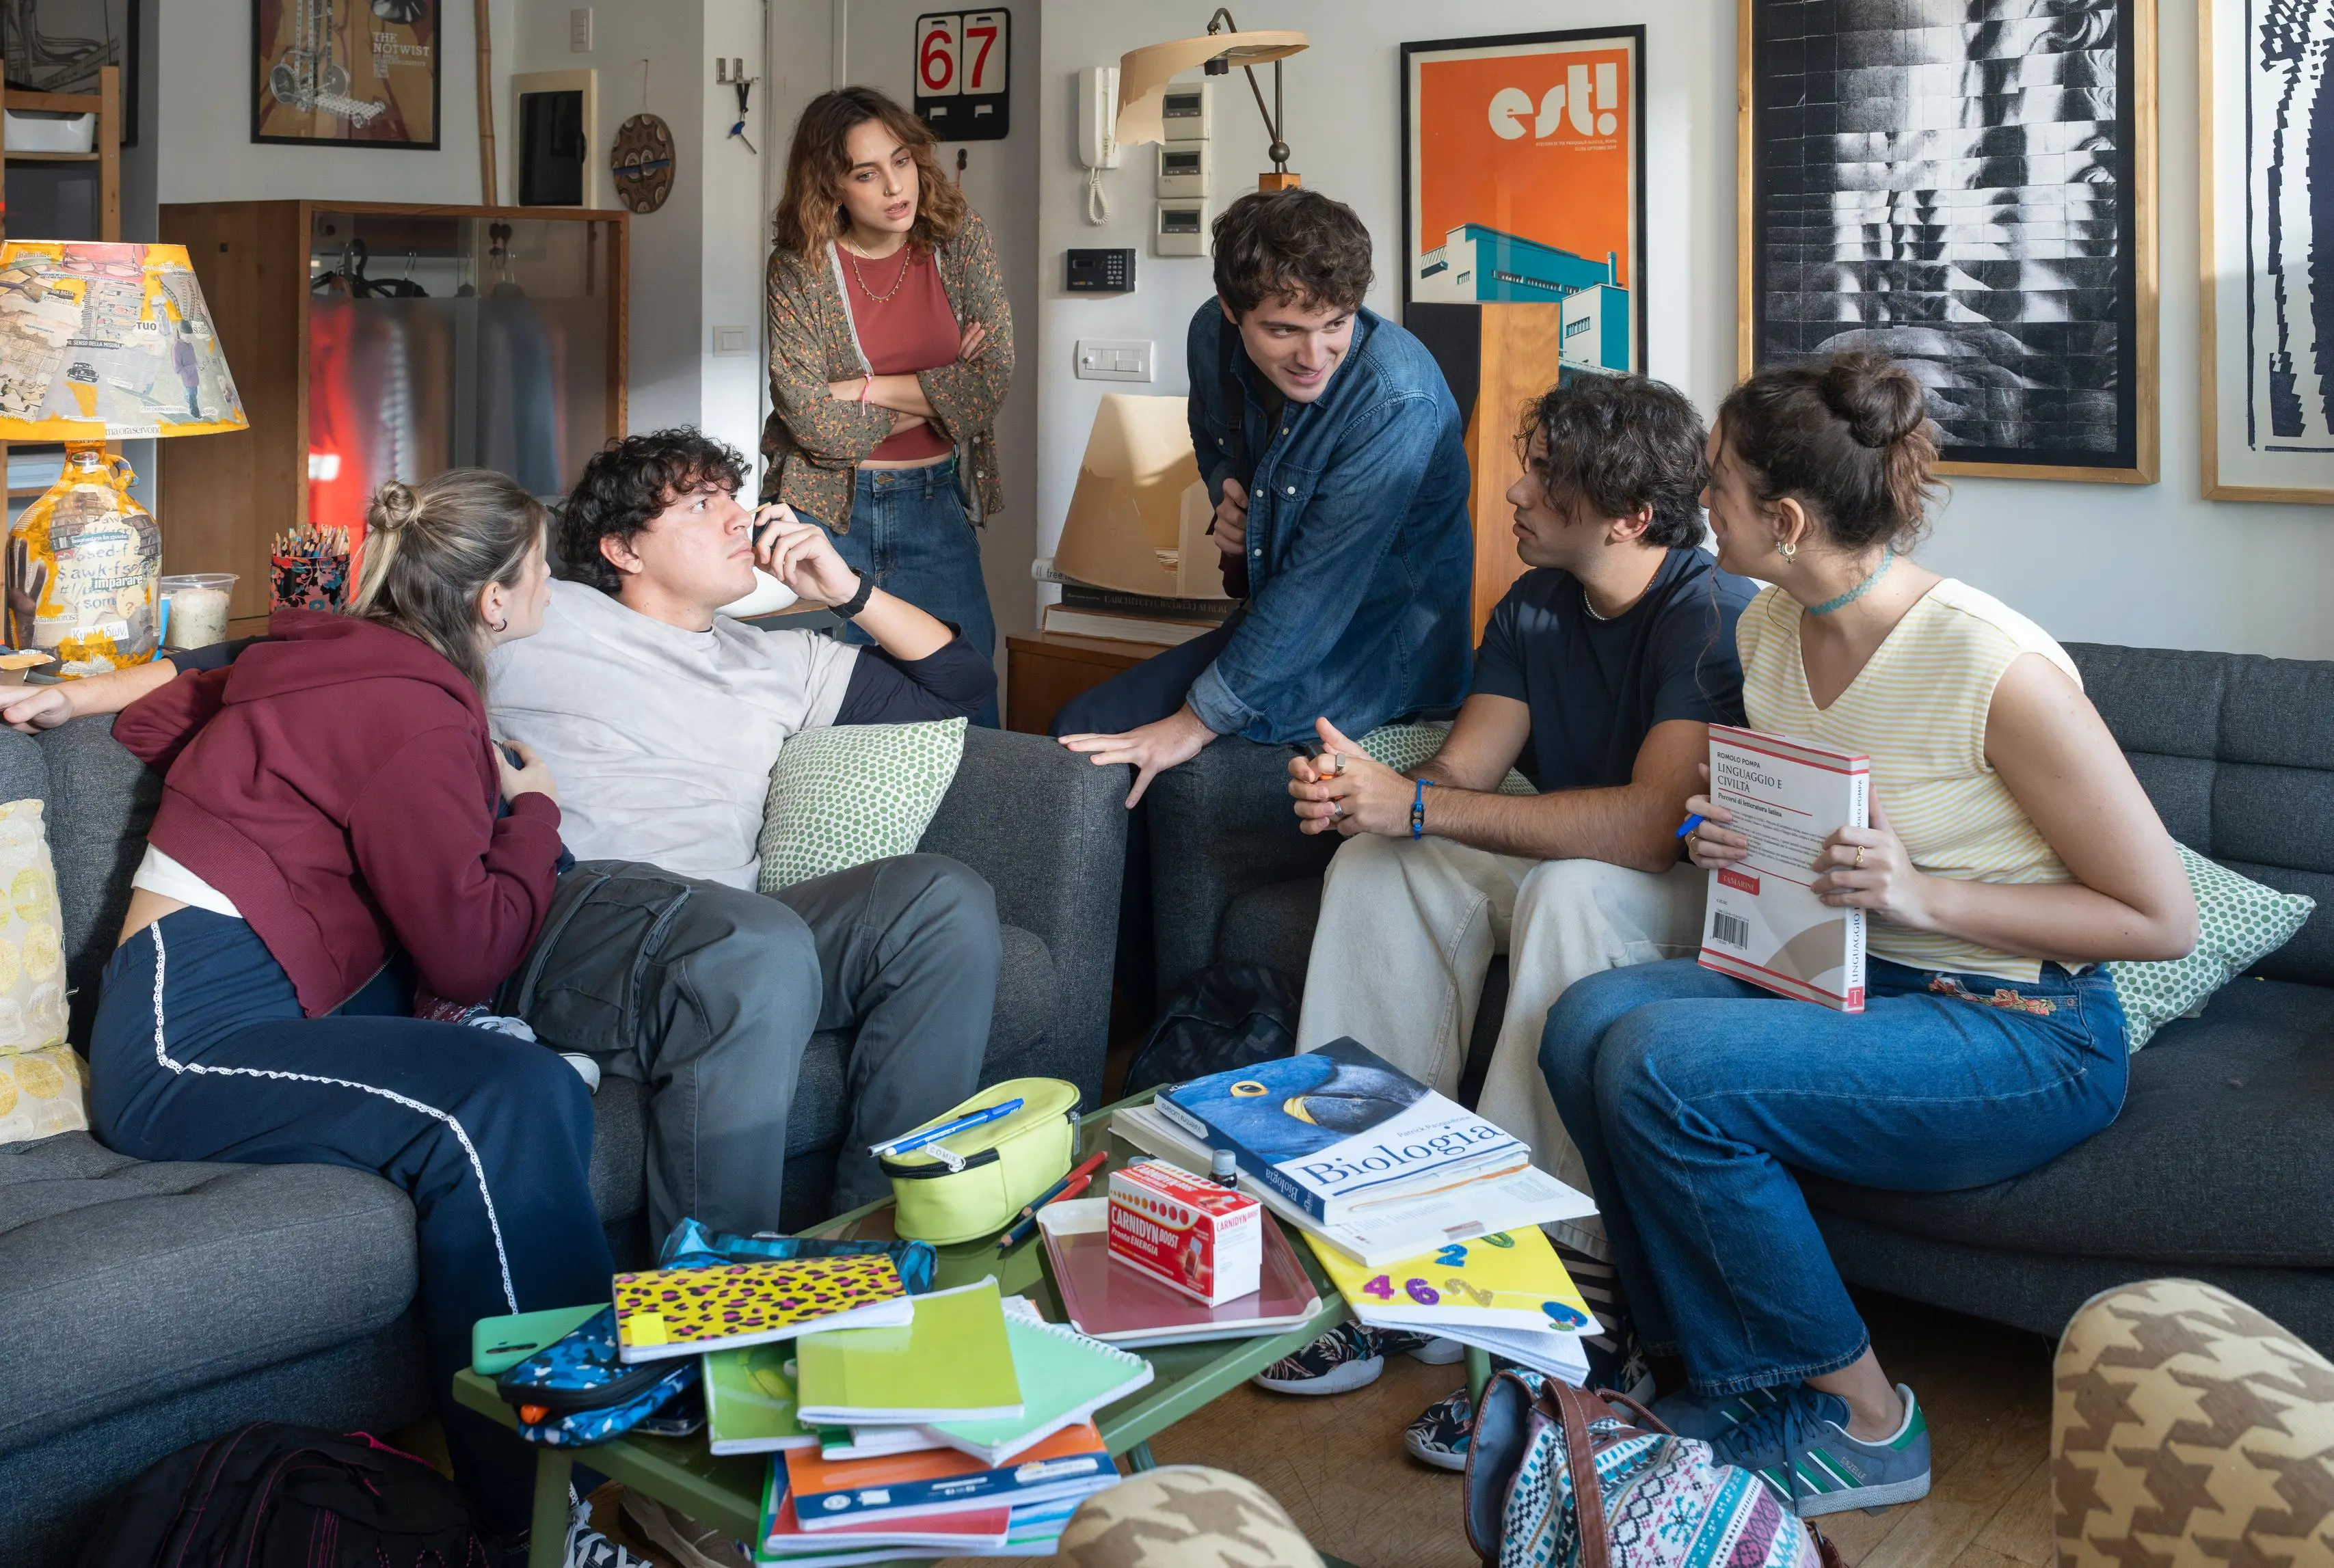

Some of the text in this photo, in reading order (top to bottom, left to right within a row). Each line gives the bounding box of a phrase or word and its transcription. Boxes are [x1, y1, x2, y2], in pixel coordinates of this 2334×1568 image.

[373, 31, 397, 42] THE
[373, 43, 429, 56] NOTWIST
[920, 26, 997, 90] 67
[1488, 63, 1618, 140] est!
[137, 322, 157, 331] TUO
[132, 426, 161, 435] servono
[94, 574, 143, 590] imparare
[1047, 568, 1063, 580] tree
[1717, 752, 1760, 769] ROMOLO POMPA
[1717, 775, 1750, 793] CIVILTÀ
[1718, 762, 1782, 789] LINGUAGGIO E
[1718, 792, 1737, 805] Percorsi
[1743, 798, 1768, 813] letteratura
[1768, 807, 1782, 817] latina
[1723, 875, 1754, 891] TAMARINI
[1852, 913, 1860, 982] LINGUAGGIO
[1162, 1103, 1201, 1133] Valentina Luciano
[1397, 1126, 1425, 1137] Patrick
[930, 1146, 956, 1163] COMIX
[1295, 1126, 1505, 1186] Biologia
[1265, 1167, 1299, 1202] Biologia
[1112, 1205, 1159, 1245] CARNIDYN
[1159, 1231, 1179, 1249] BOOST
[1216, 1215, 1247, 1232] CARNIDYN
[1111, 1227, 1158, 1256] Pronta ENERGIA
